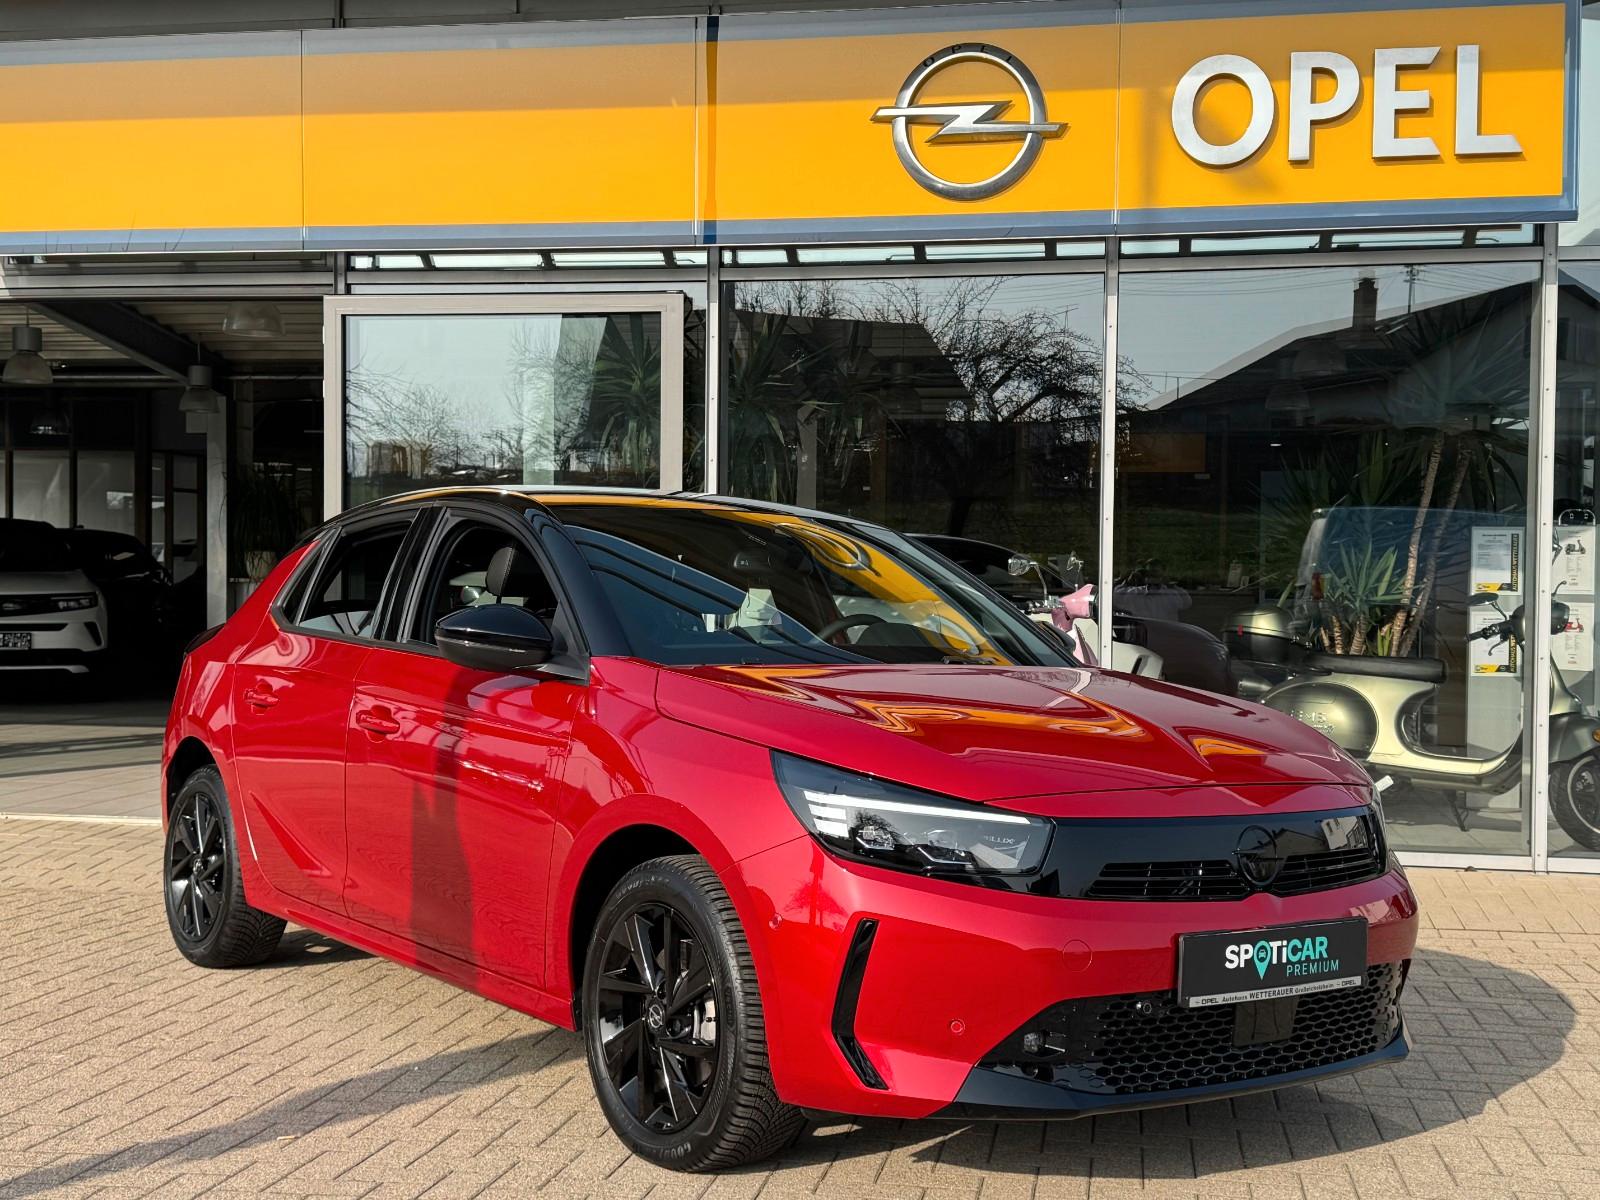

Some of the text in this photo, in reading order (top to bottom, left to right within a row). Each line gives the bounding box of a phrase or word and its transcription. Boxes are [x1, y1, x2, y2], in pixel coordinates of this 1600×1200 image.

[922, 44, 1014, 68] OPEL
[1171, 45, 1523, 166] OPEL
[1286, 959, 1339, 977] PREMIUM
[1201, 997, 1219, 1005] OPEL
[1222, 994, 1248, 1003] Autohaus
[1249, 987, 1294, 1000] WETTERAUER
